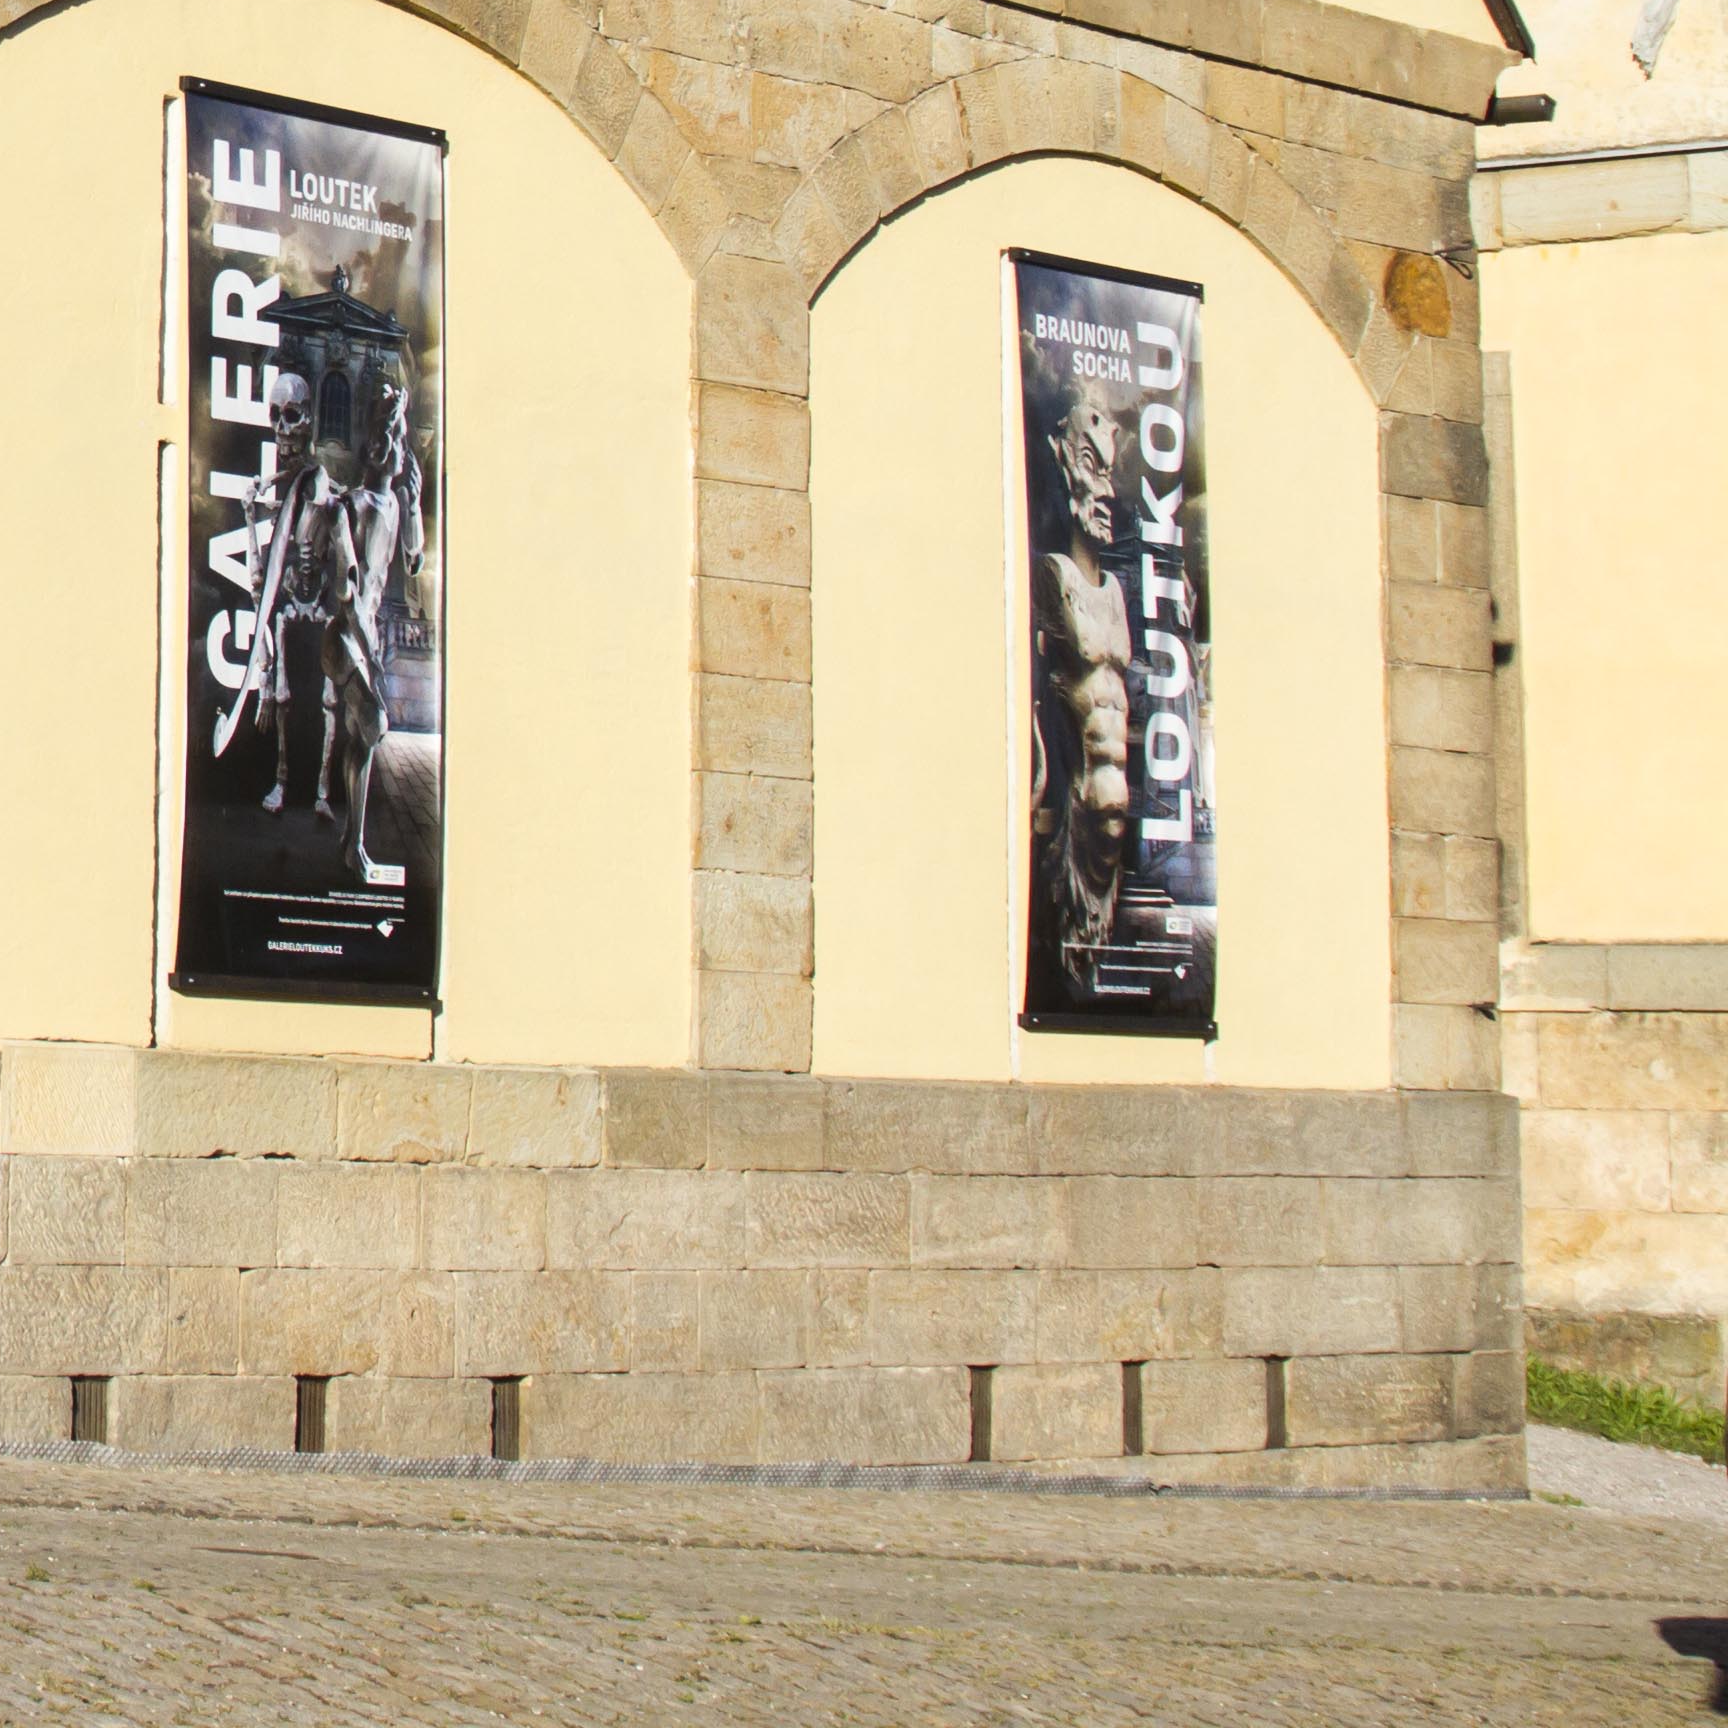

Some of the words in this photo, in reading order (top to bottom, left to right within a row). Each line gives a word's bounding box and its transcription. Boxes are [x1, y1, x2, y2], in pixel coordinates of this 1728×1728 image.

[290, 169, 378, 214] LOUTEK
[290, 202, 331, 225] JIŘÍHO
[332, 211, 413, 241] NACHLINGERA
[1035, 313, 1132, 354] BRAUNOVA
[1072, 350, 1132, 383] SOCHA
[206, 138, 281, 691] GALERIE
[1137, 321, 1194, 842] LOUTKOU
